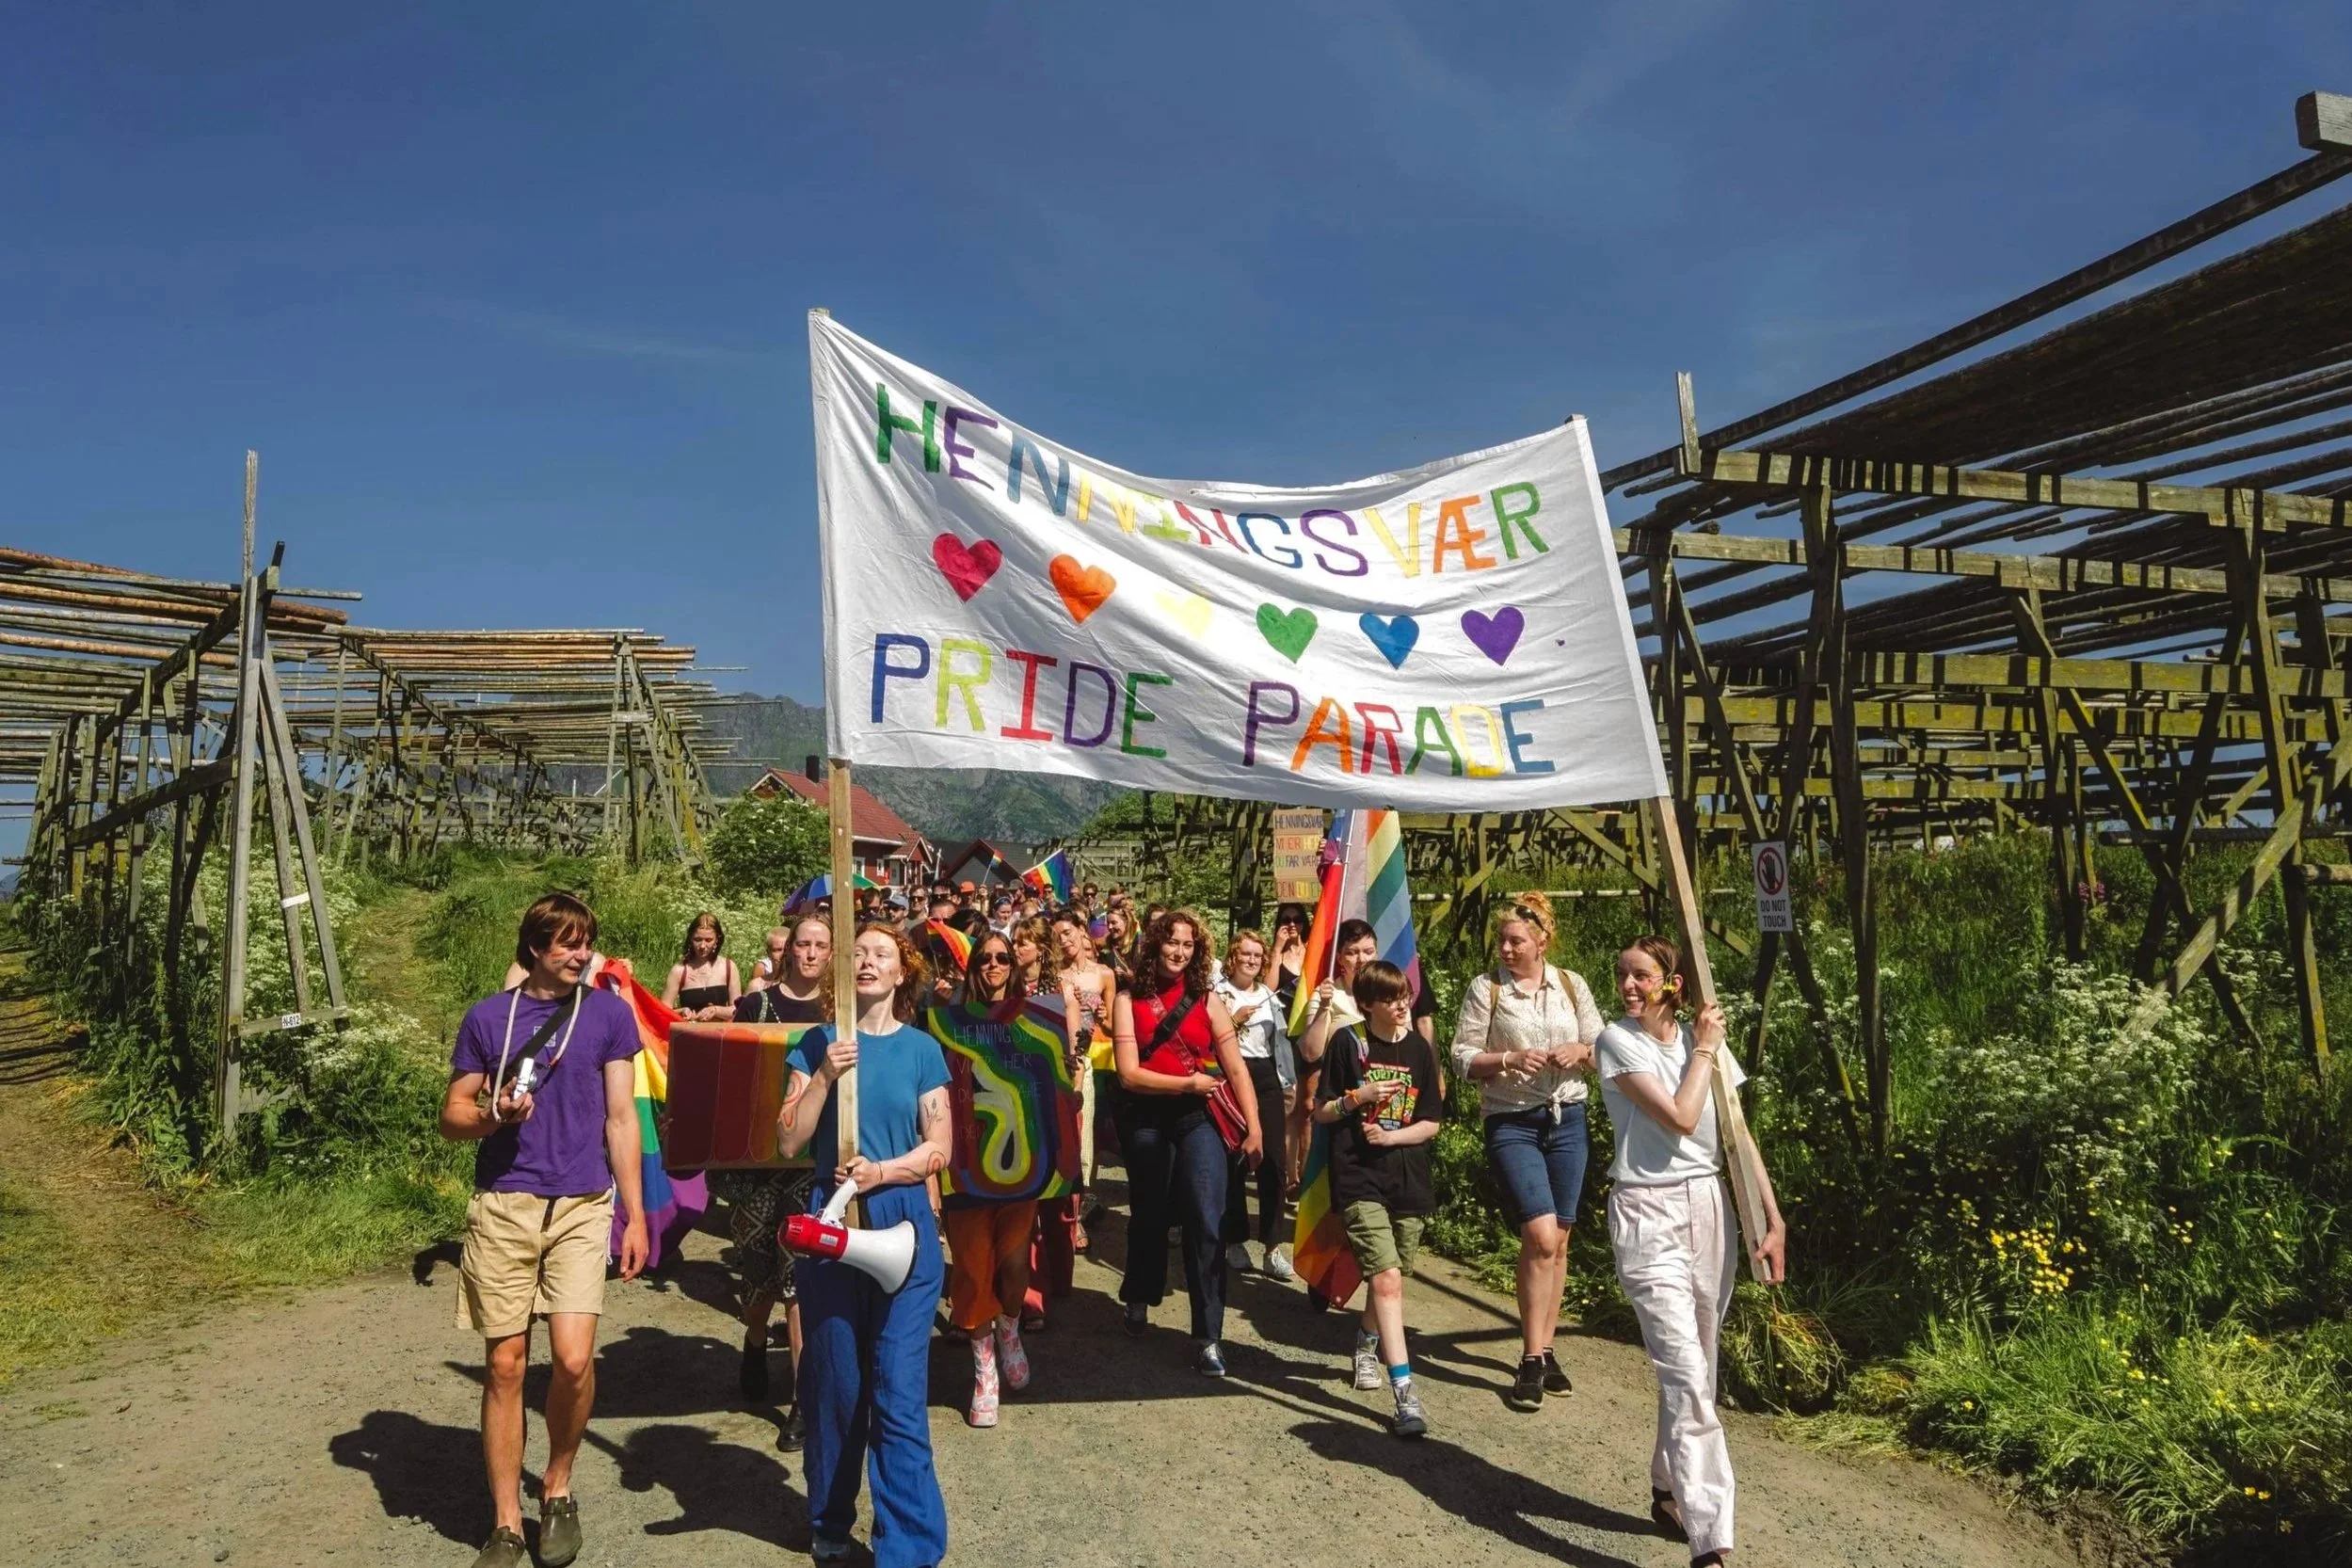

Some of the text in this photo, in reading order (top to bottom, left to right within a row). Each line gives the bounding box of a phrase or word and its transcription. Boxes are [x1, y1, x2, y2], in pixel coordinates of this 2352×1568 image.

[876, 383, 1551, 578] HENNINGSVÆR
[871, 632, 1557, 778] PRIDE PARADE
[1760, 899, 1785, 911] DO NOT
[1762, 914, 1786, 927] TOUCH
